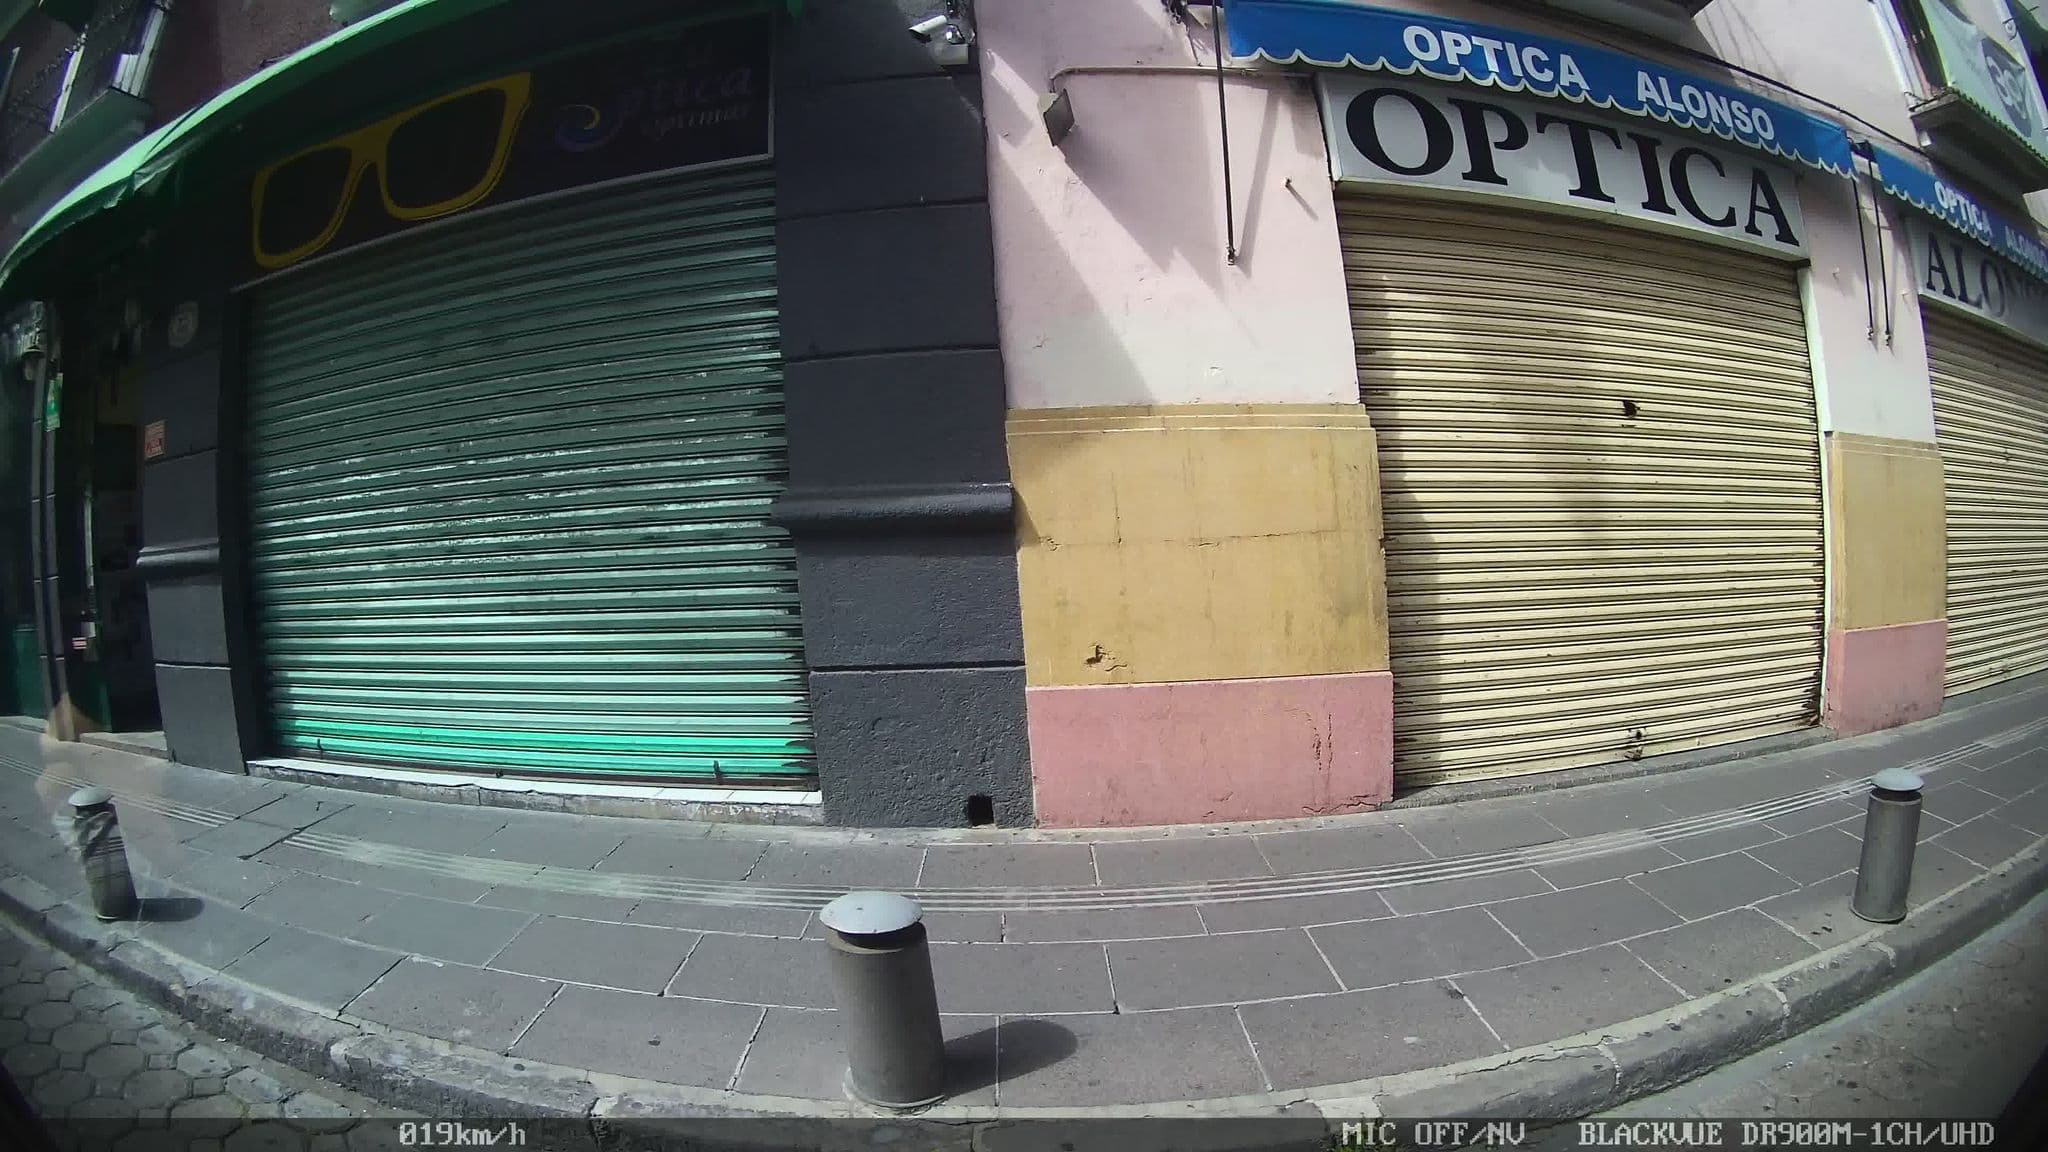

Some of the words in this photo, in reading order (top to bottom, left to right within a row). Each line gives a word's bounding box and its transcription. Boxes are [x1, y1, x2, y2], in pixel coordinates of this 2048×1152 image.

[1402, 25, 1591, 91] OPTICA
[1636, 70, 1774, 141] ALONSO
[1345, 86, 1800, 247] OPTICA
[1934, 180, 1993, 237] OPTICA
